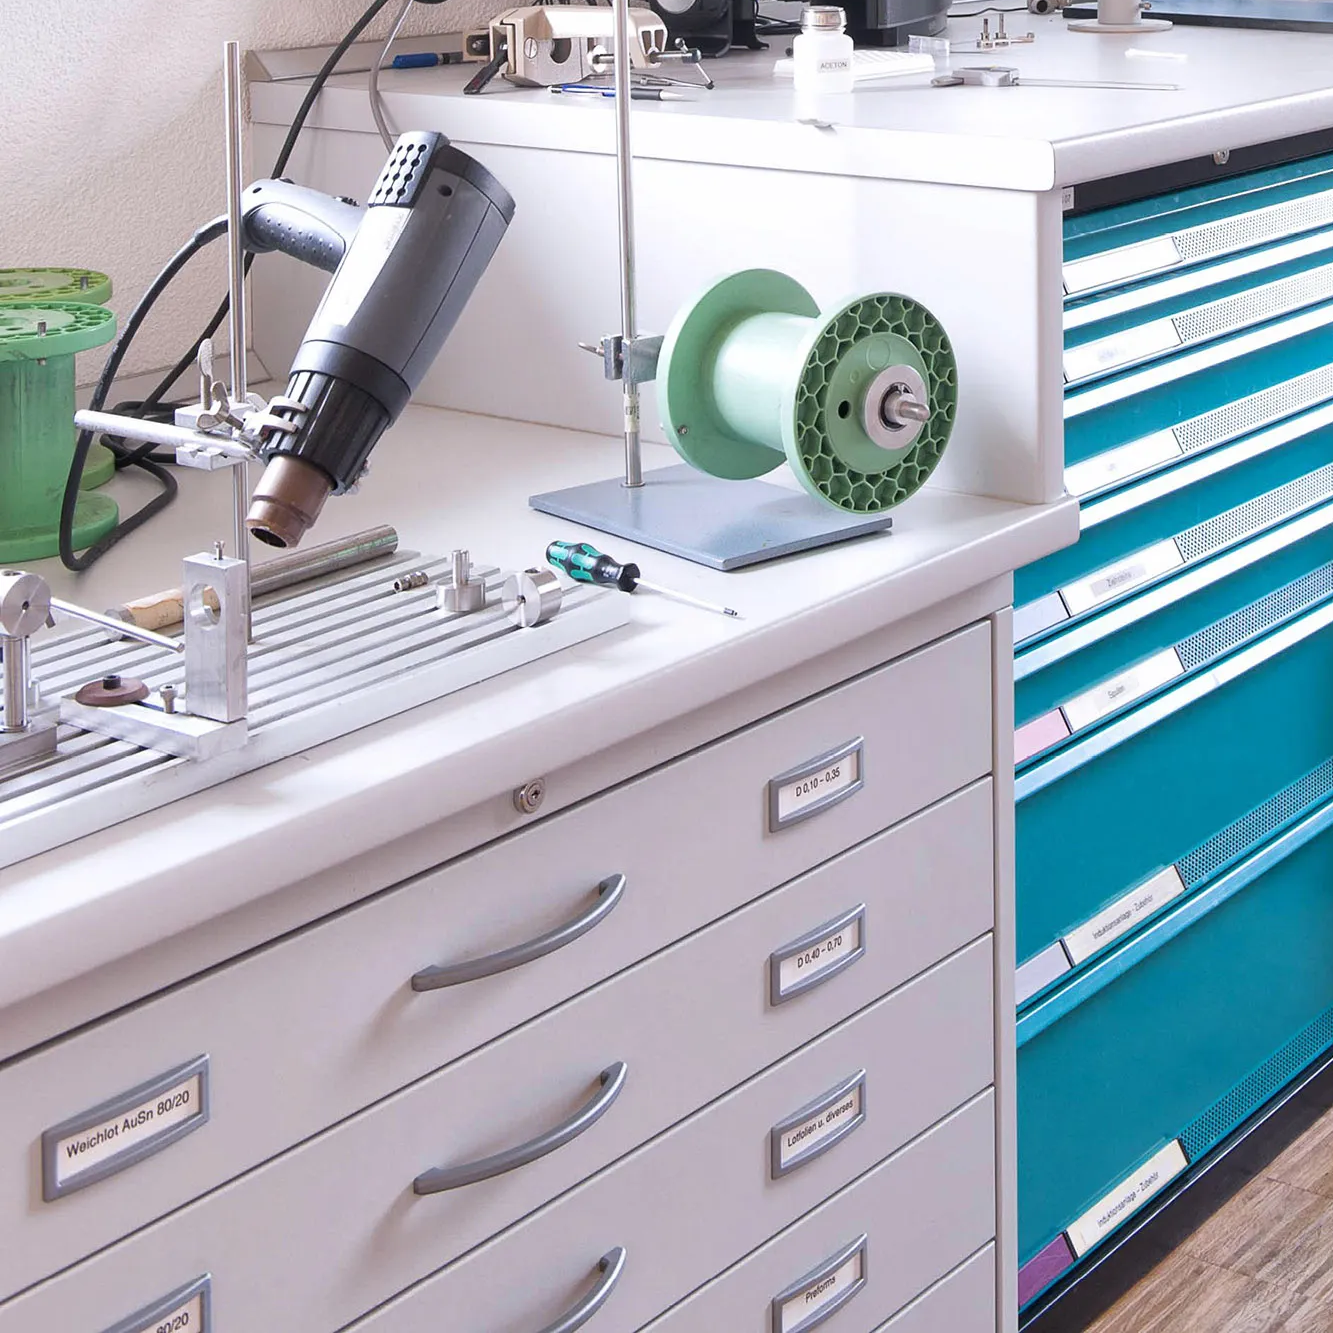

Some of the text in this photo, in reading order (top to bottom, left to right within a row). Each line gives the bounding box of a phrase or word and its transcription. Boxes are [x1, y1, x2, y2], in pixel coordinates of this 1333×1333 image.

[820, 61, 848, 69] ACETON
[795, 786, 802, 797] D
[802, 778, 819, 794] 0,10
[825, 766, 841, 783] 0,35
[797, 957, 804, 968] D
[804, 947, 820, 964] 0,40
[827, 935, 842, 952] 0,70
[66, 1090, 190, 1159] Weichlot AuSn 80/20
[825, 1099, 854, 1123] diverses
[805, 1275, 836, 1303] Preforms
